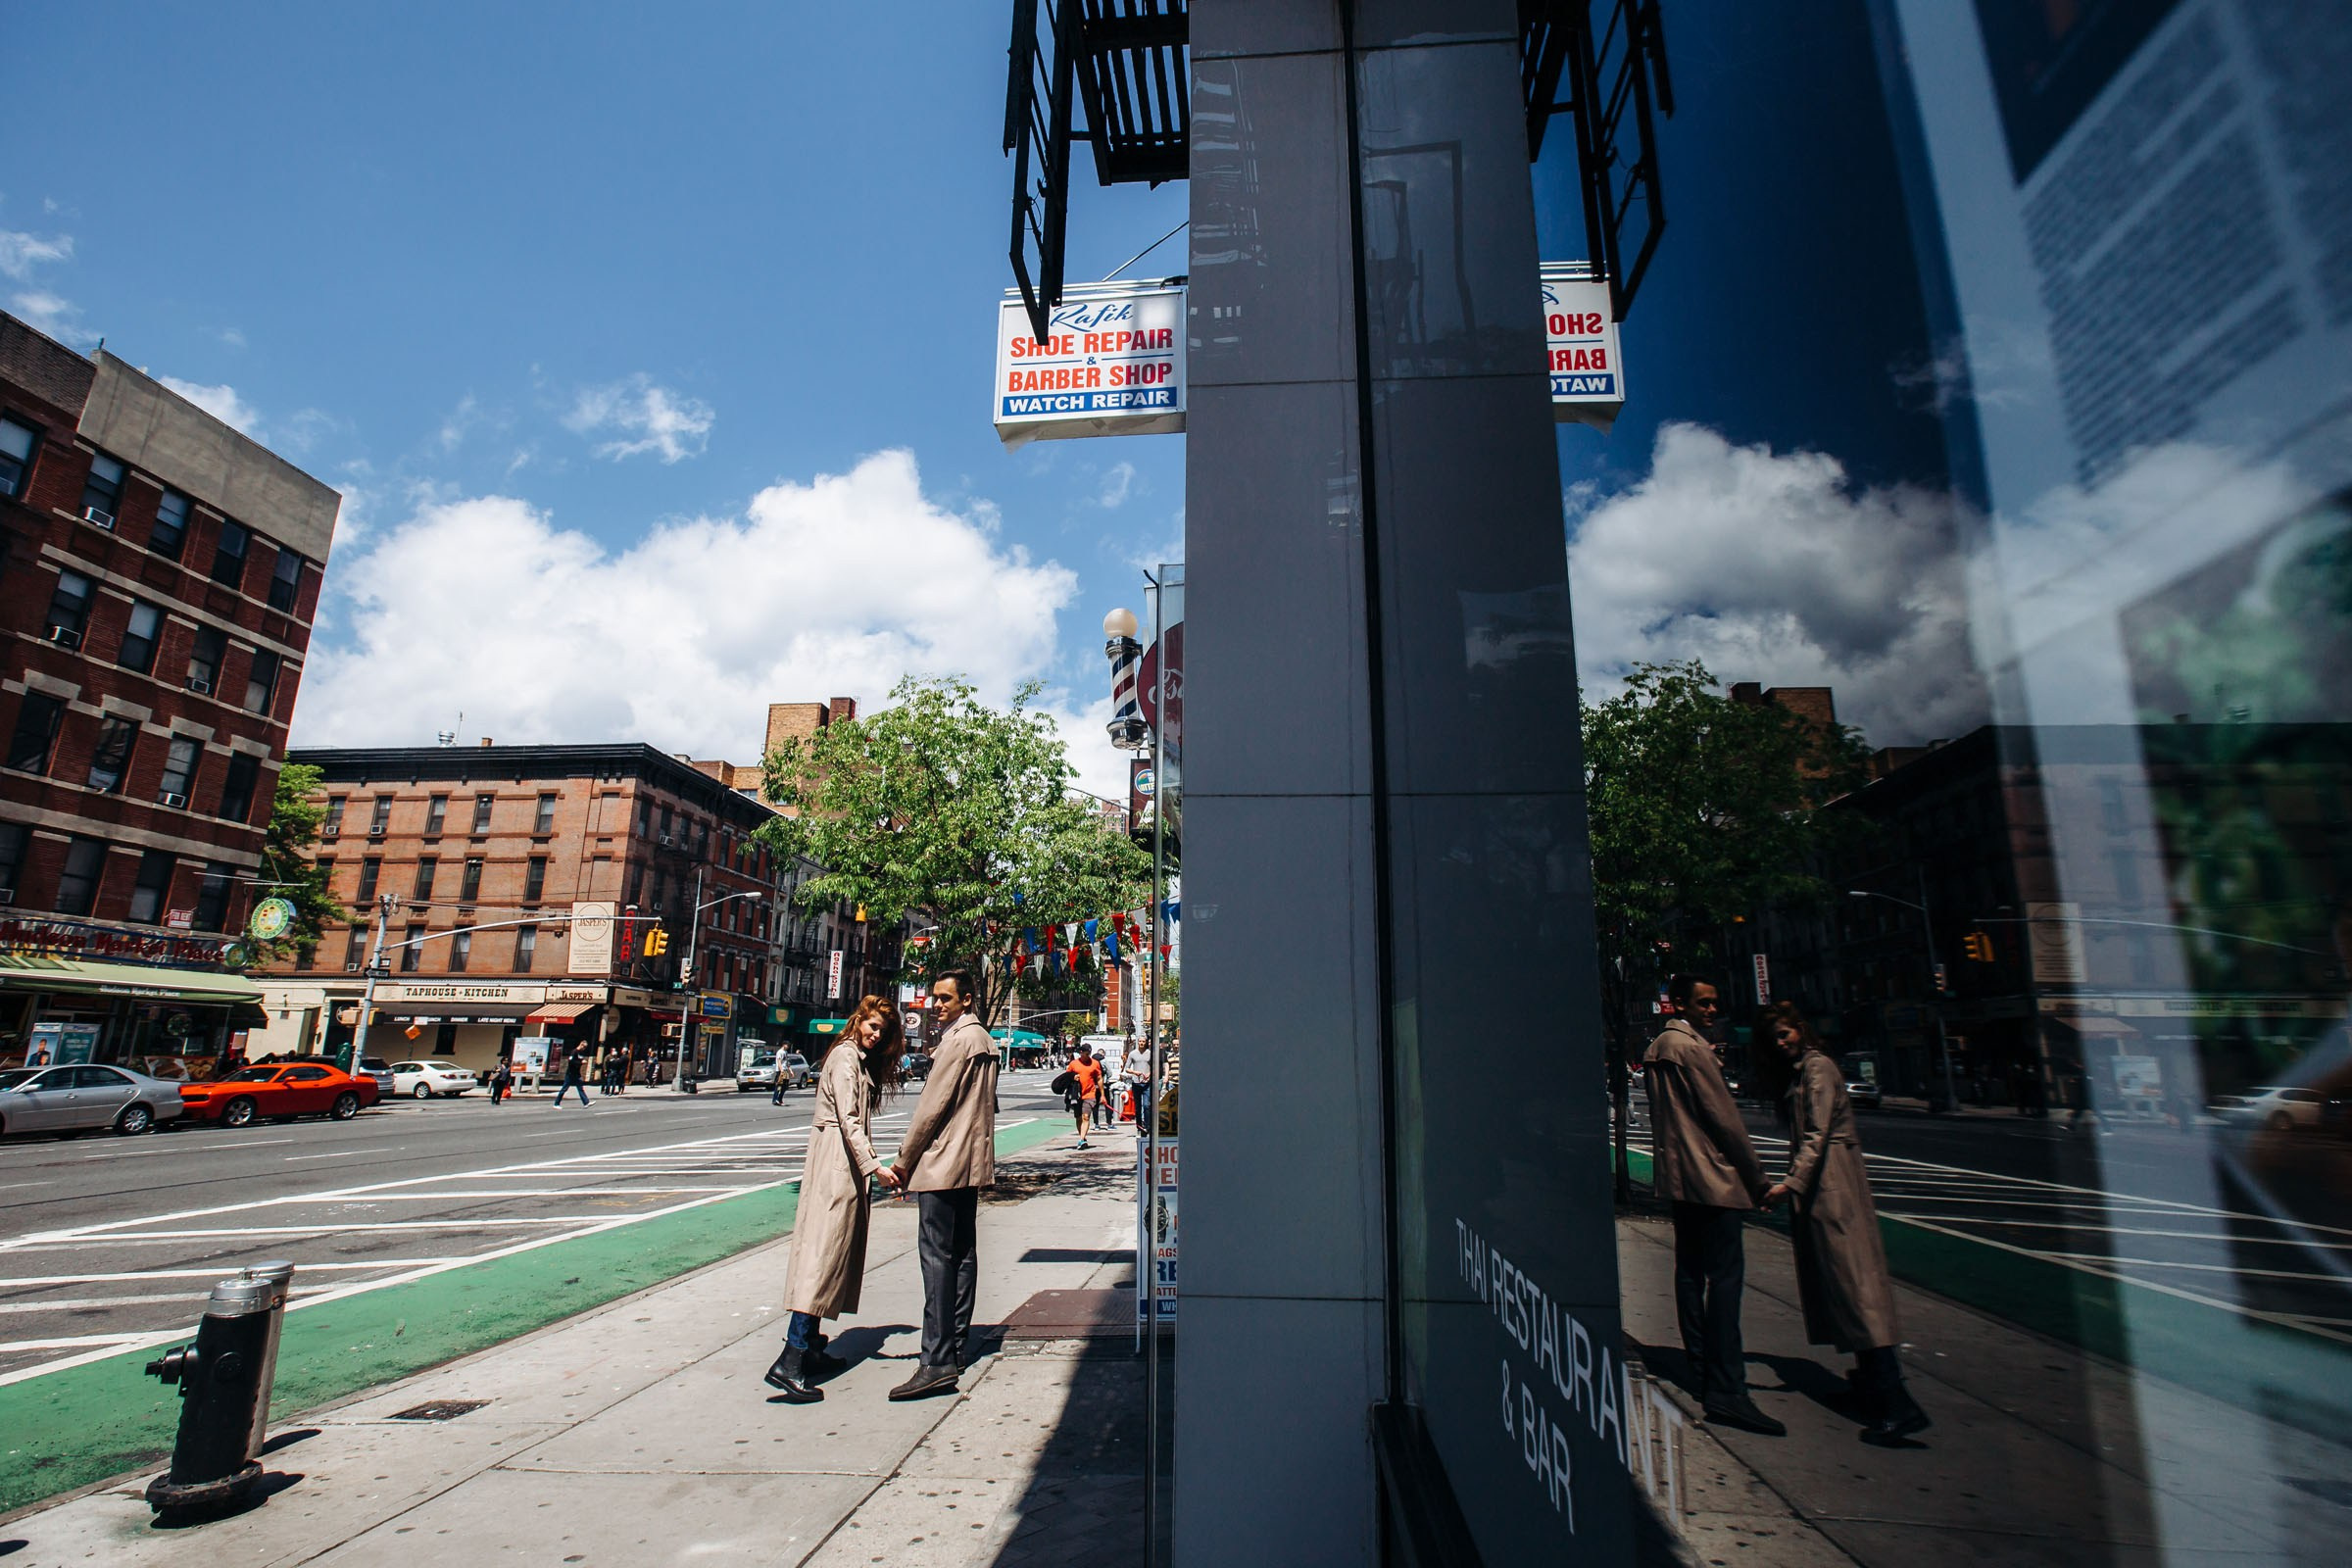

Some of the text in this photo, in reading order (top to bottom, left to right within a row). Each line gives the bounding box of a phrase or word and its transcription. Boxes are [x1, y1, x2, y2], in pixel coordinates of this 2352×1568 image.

[1050, 304, 1133, 332] Rafik
[1010, 328, 1173, 358] SHOE REPAIR
[1086, 356, 1097, 366] &
[1008, 363, 1173, 392] BARBER SHOP
[1008, 390, 1170, 413] WATCH REPAIR
[95, 930, 167, 959] Market
[173, 940, 224, 961] Place
[621, 910, 635, 961] BAR
[406, 988, 509, 998] TAPHOUSE KITCHEN
[1456, 1218, 1683, 1529] THAI RESTAURANT
[1501, 1359, 1575, 1536] & BAR
